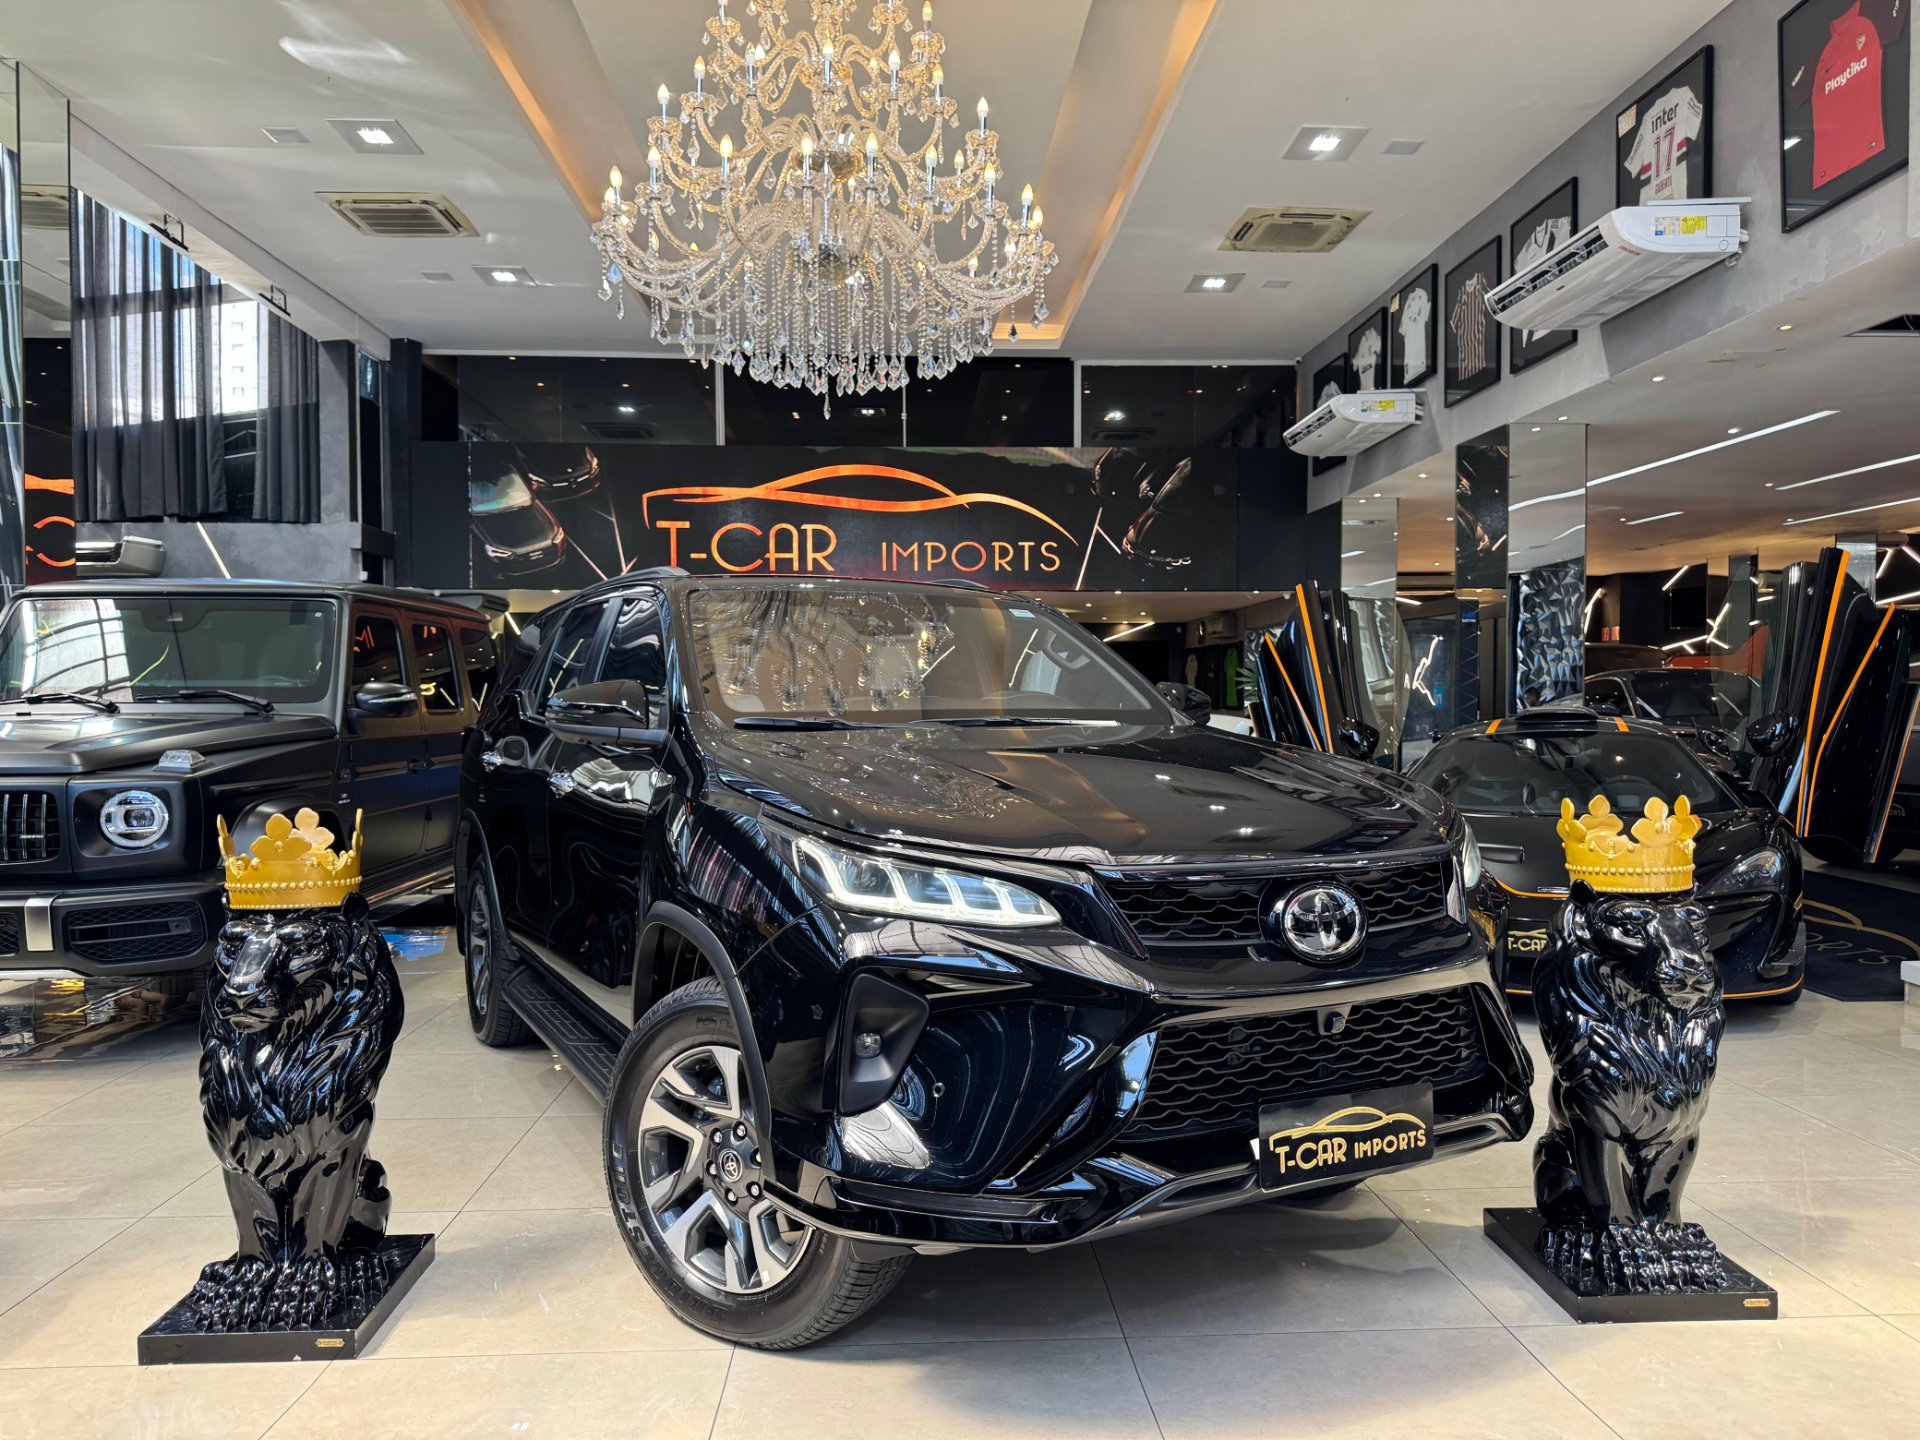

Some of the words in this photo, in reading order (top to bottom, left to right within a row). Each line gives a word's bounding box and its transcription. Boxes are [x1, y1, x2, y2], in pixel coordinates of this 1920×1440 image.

[1825, 56, 1868, 95] Playtika
[1651, 102, 1680, 134] inter
[1653, 124, 1676, 180] 17
[656, 520, 838, 572] T-CAR
[881, 540, 1061, 572] IMPORTS
[1274, 1137, 1348, 1175] T-CAR
[1354, 1129, 1427, 1160] IMPORTS
